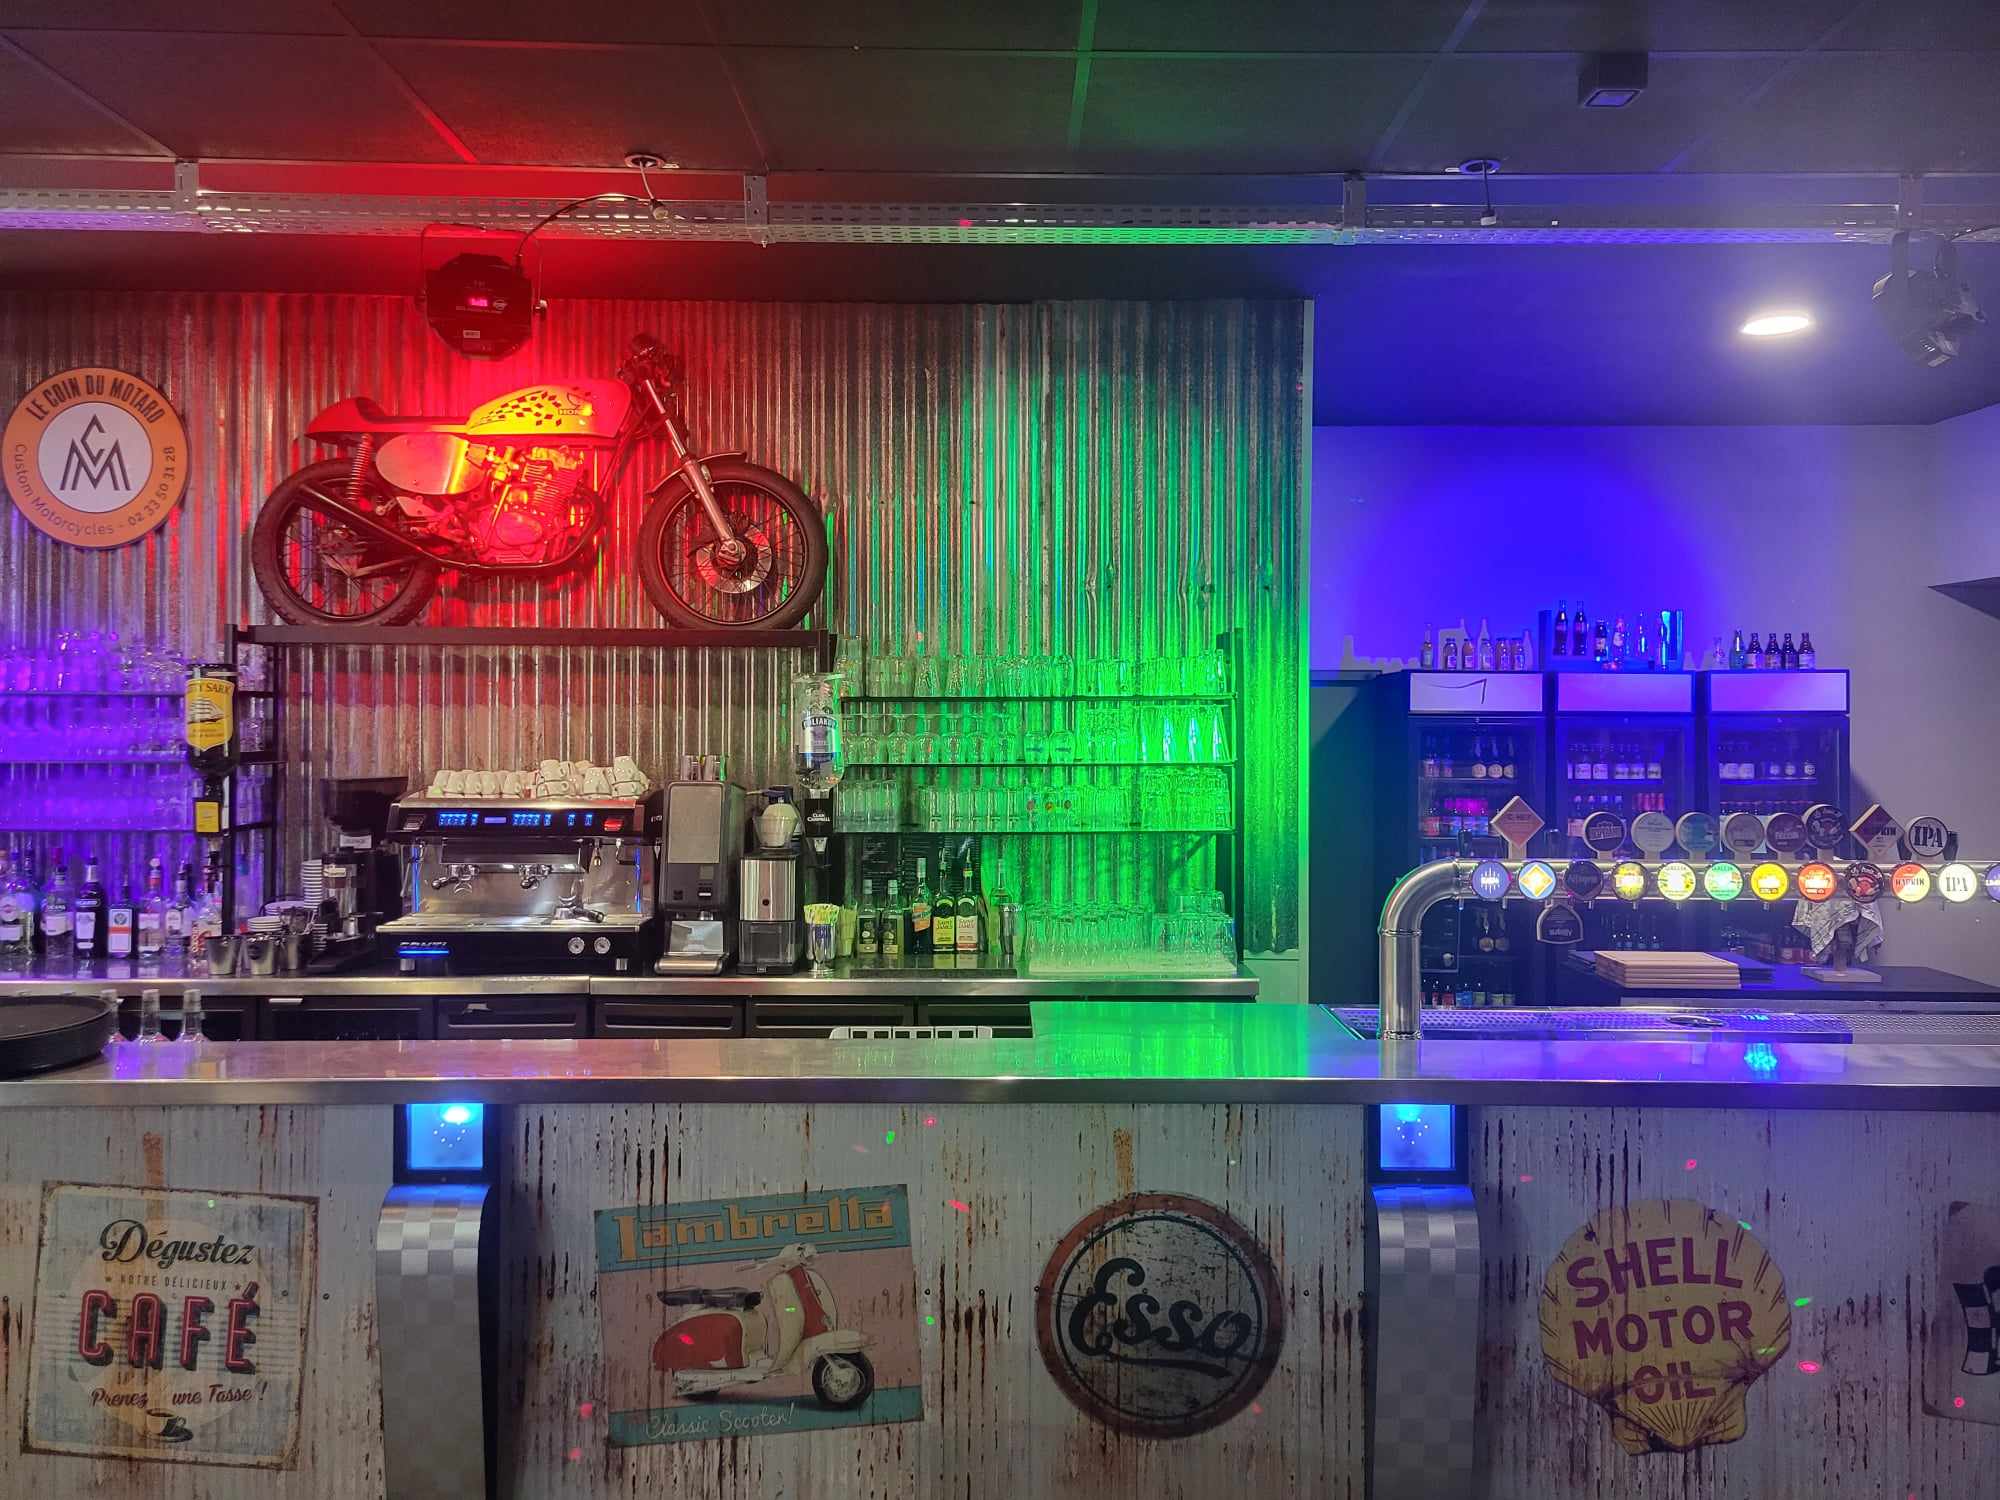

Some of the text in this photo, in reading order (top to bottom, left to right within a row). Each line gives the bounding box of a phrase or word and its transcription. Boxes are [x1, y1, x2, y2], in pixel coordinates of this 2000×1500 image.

[26, 375, 165, 424] LE COIN DU MOTARD
[14, 443, 33, 497] Custom
[31, 496, 114, 537] Motorcycles
[1914, 825, 1944, 849] IPA
[1945, 876, 1969, 892] IPA
[100, 1219, 256, 1270] Dégustez
[1566, 1236, 1744, 1309] SHELL
[78, 1281, 261, 1375] CAFÉ
[1068, 1257, 1254, 1377] Esso
[1573, 1300, 1755, 1360] MOTOR
[91, 1387, 149, 1409] Prenez
[172, 1389, 203, 1406] une
[1632, 1360, 1717, 1405] OIL
